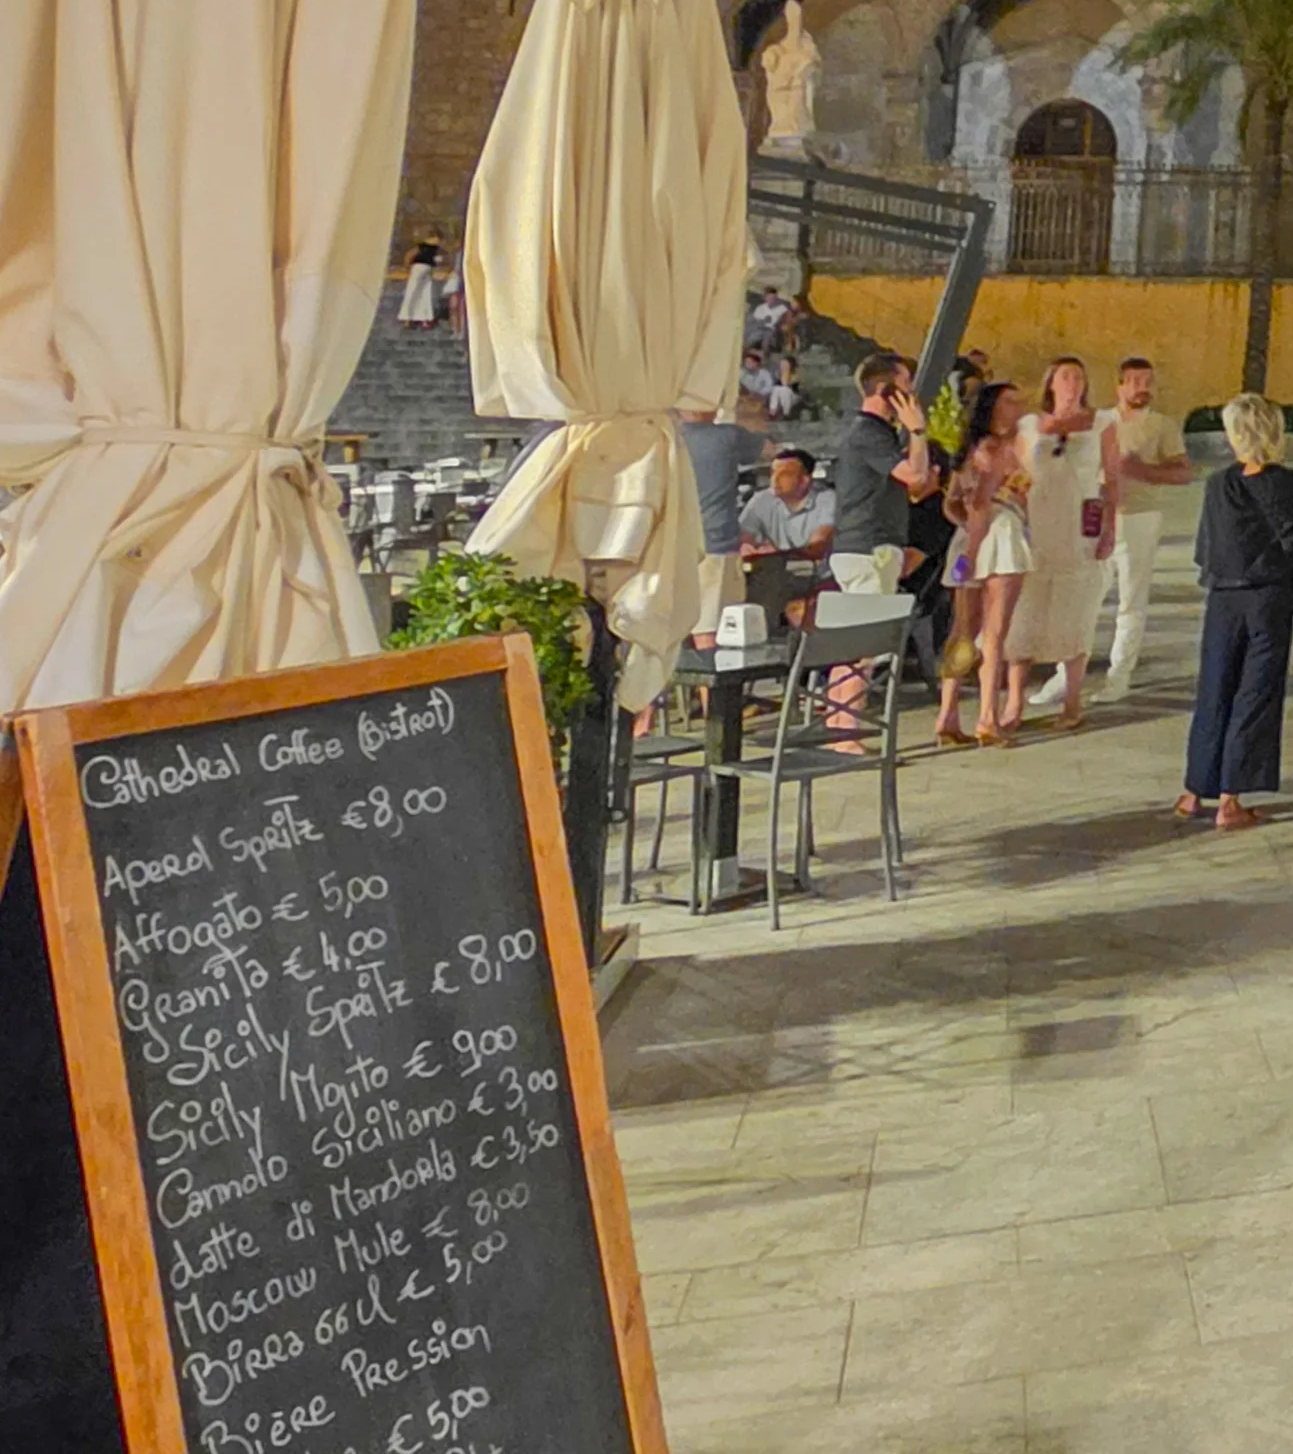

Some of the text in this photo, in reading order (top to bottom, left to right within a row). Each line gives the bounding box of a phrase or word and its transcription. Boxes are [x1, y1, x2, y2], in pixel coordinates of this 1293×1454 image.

[258, 727, 344, 772] Coffee
[113, 891, 262, 973] Affogato
[166, 1003, 291, 1102] Sicily
[147, 1081, 262, 1167] Sicily
[290, 1055, 389, 1139] Mojito
[312, 1098, 457, 1168] Siciliano
[286, 1200, 316, 1242] di
[174, 1266, 317, 1349] Moscow
[333, 1222, 412, 1274] Mule
